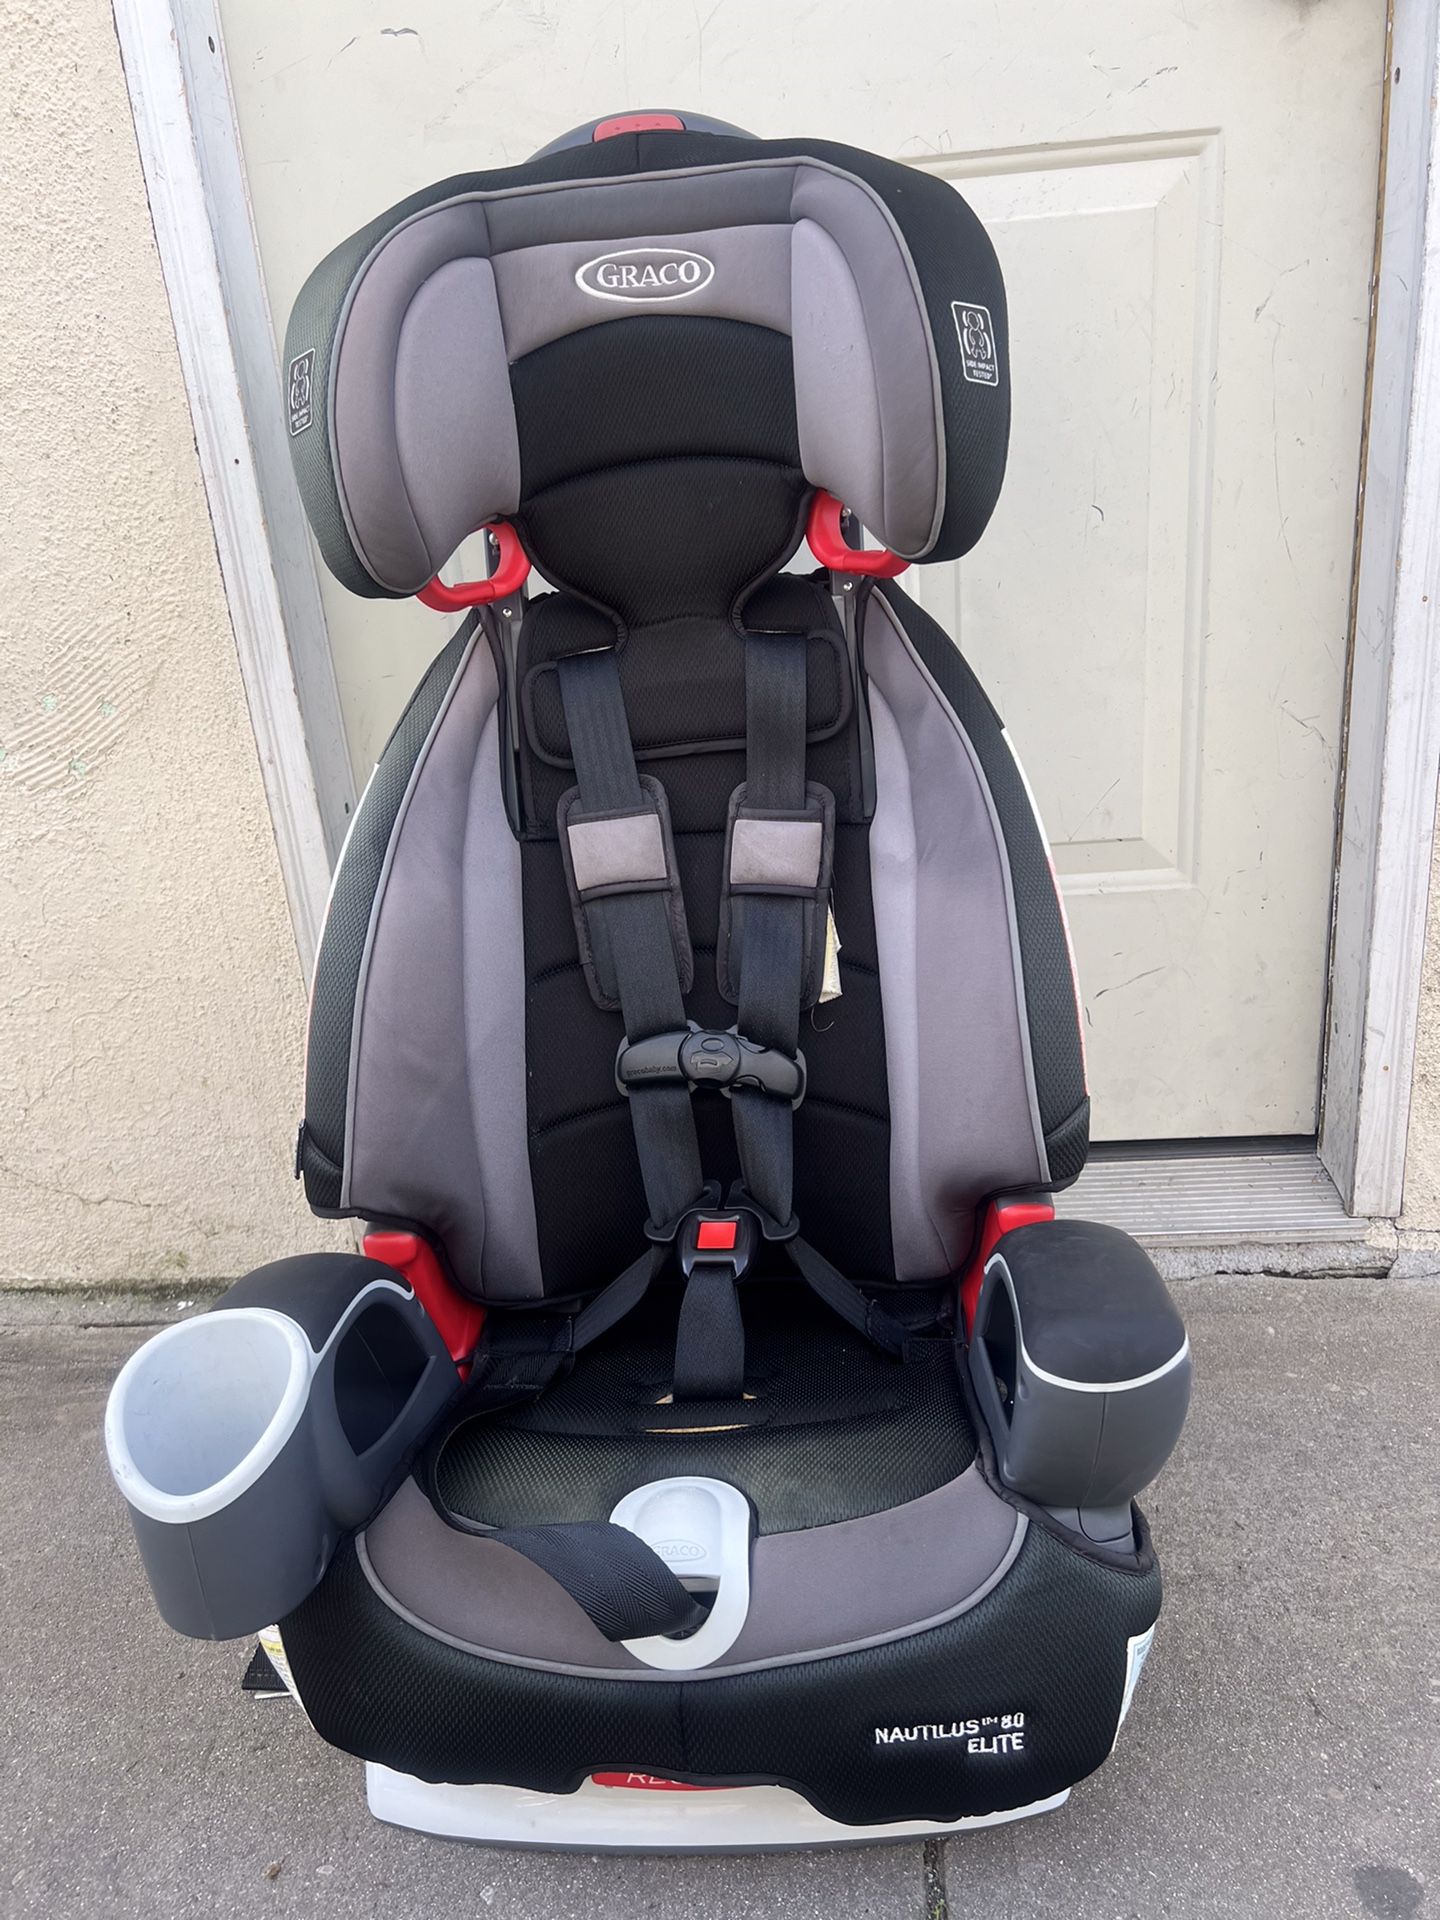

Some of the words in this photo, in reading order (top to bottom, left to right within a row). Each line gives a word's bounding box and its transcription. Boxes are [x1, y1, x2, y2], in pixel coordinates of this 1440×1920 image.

[596, 259, 701, 289] GRACO
[1000, 1711, 1025, 1729] 80
[966, 1732, 1025, 1754] ELITE
